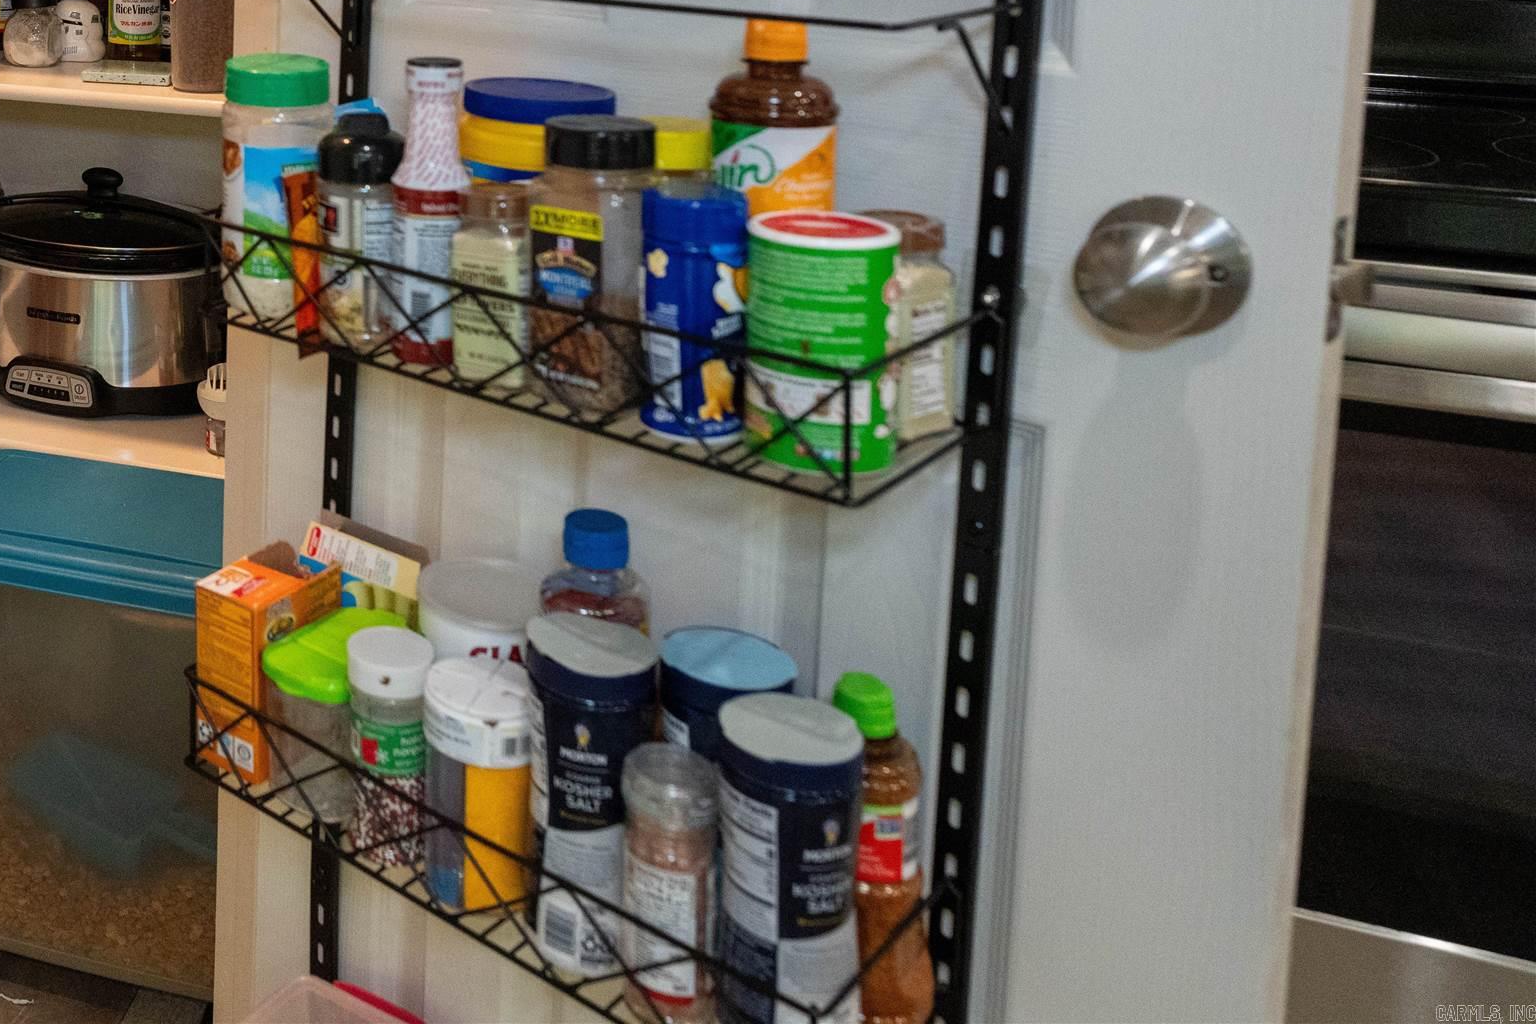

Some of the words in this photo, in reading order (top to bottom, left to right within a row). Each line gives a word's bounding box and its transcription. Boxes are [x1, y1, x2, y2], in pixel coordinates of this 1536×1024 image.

[115, 3, 133, 15] Rice
[132, 4, 160, 16] Vinegar
[553, 776, 614, 801] KOSHER
[565, 794, 602, 814] SALT
